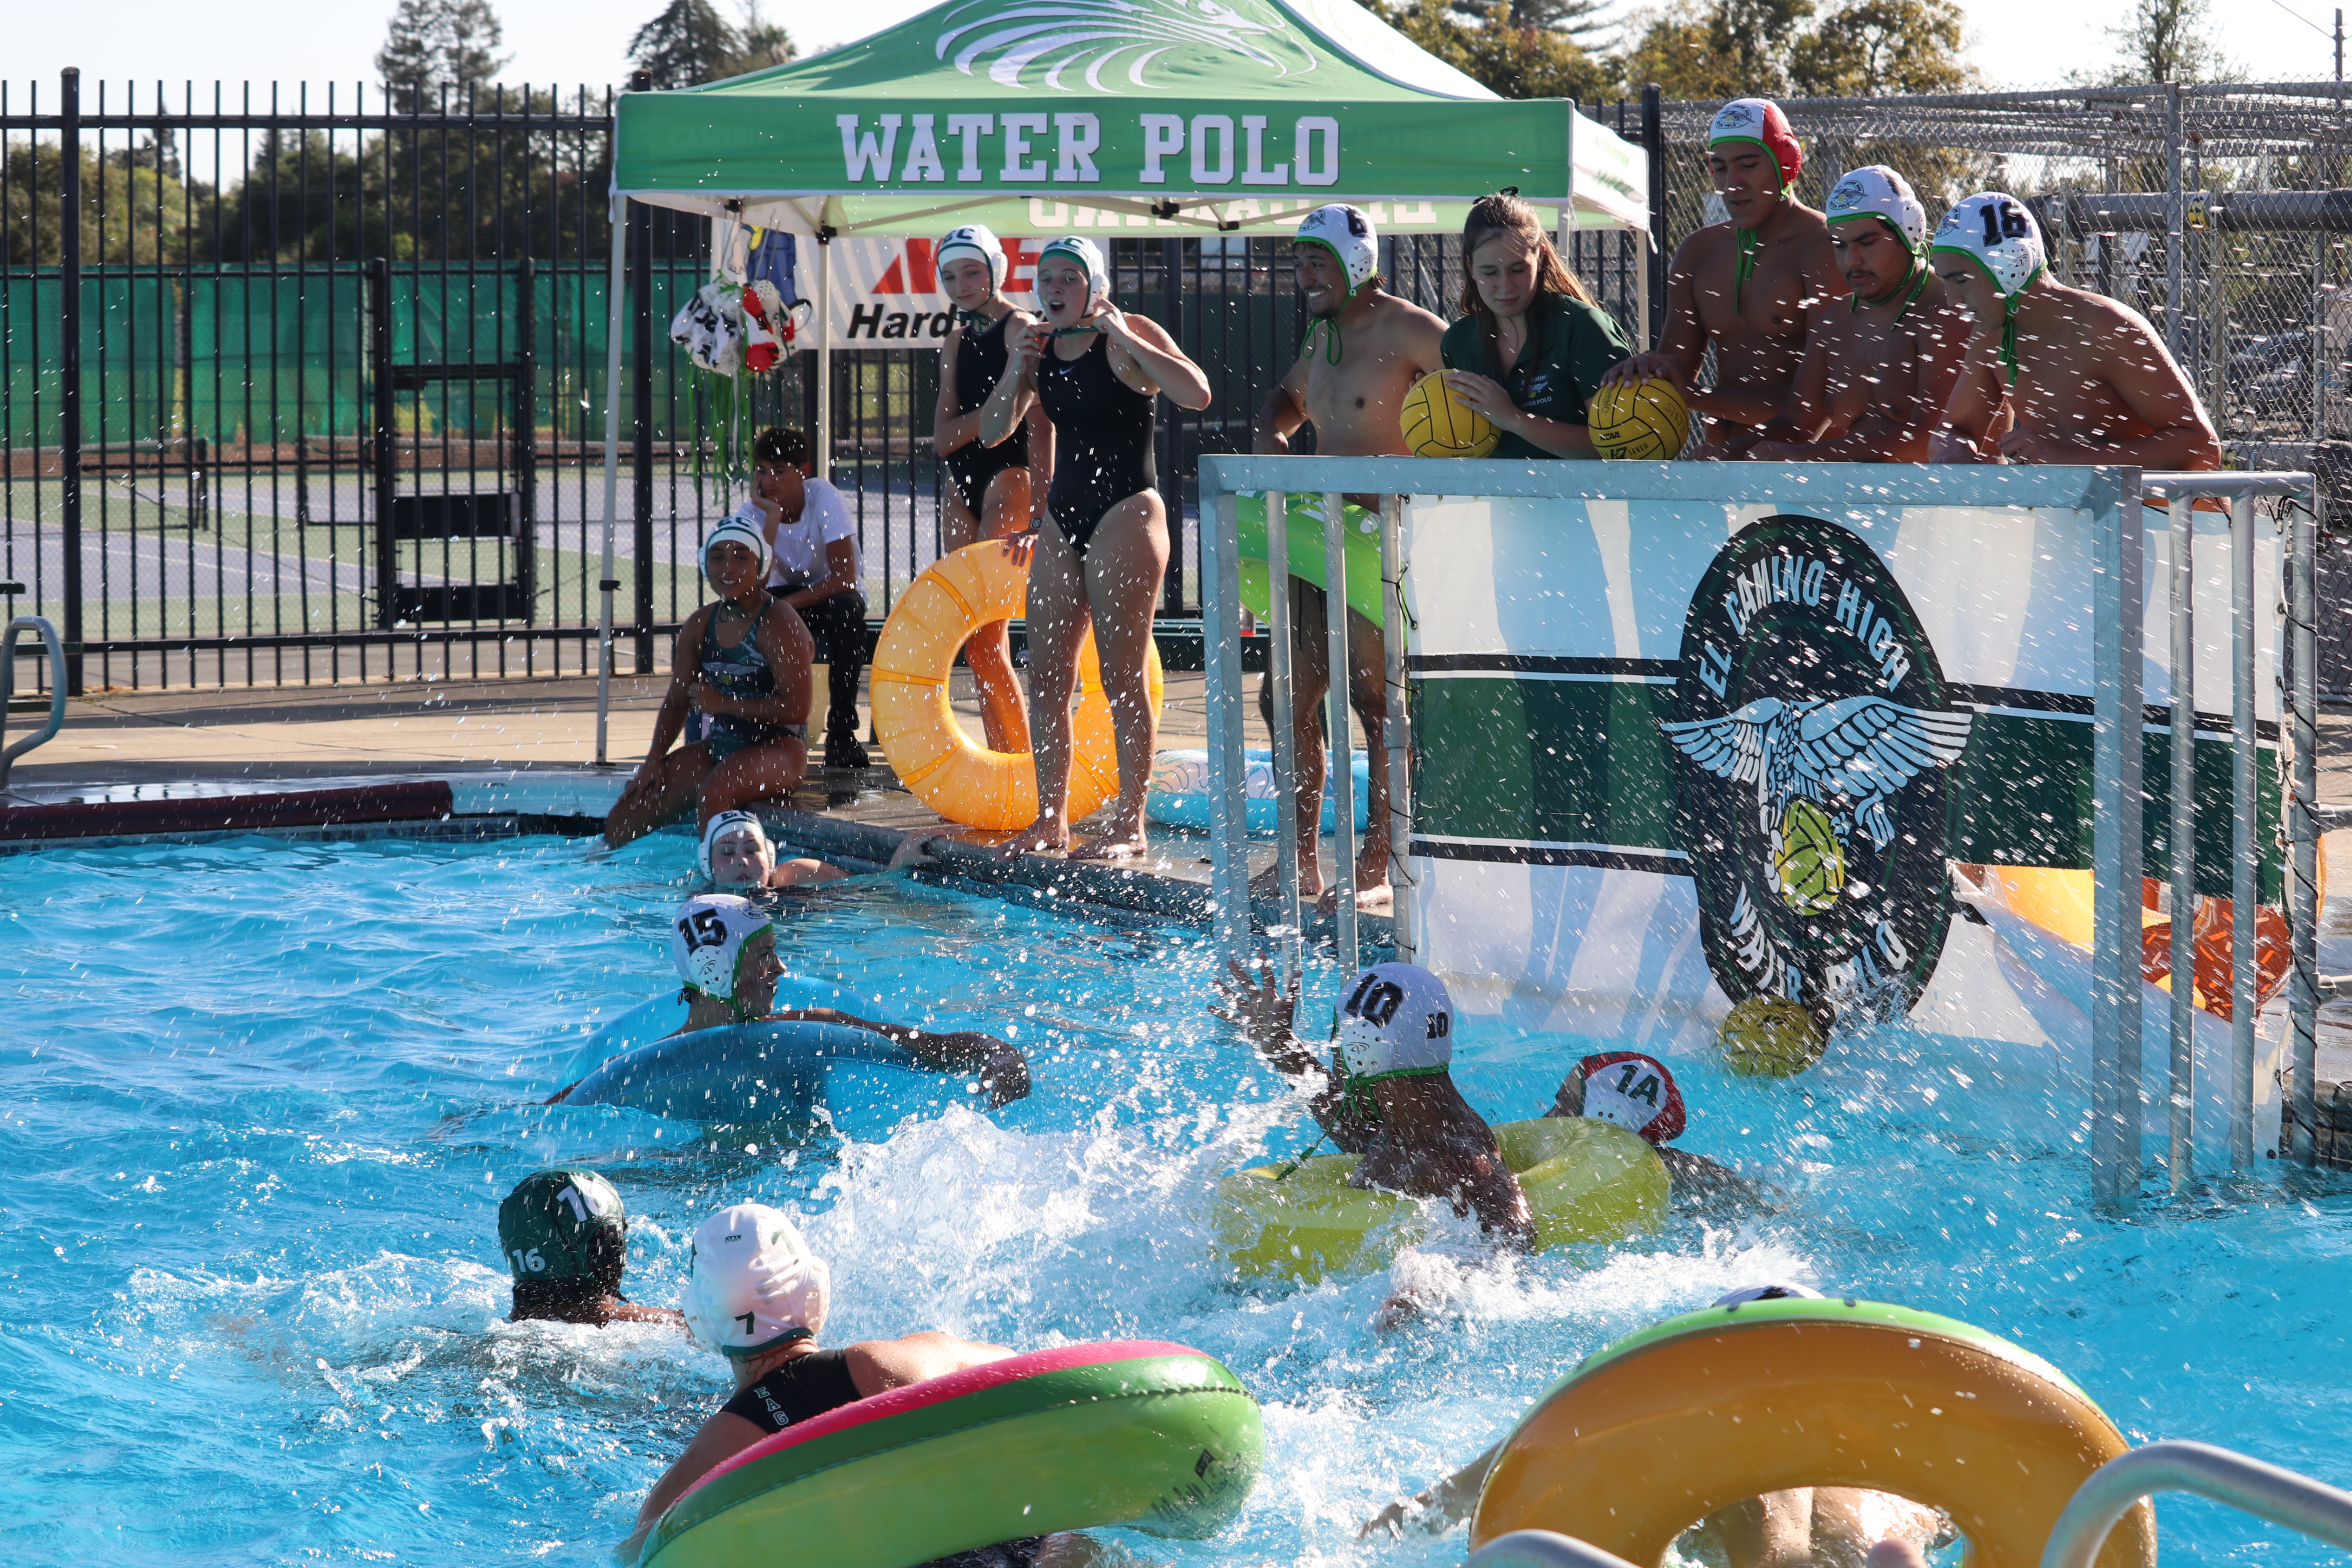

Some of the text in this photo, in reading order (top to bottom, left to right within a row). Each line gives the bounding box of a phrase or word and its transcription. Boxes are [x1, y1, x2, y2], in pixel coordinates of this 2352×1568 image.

[837, 113, 1340, 186] WATER POLO
[1628, 443, 1649, 456] SEVEN
[1699, 554, 1912, 700] EL CAMINO HIGH
[678, 907, 728, 958] 15
[1344, 972, 1404, 1028] 10
[1426, 1011, 1449, 1040] 10
[1616, 1064, 1660, 1109] 1A
[512, 1247, 546, 1273] 16
[753, 1386, 789, 1430] EAG
